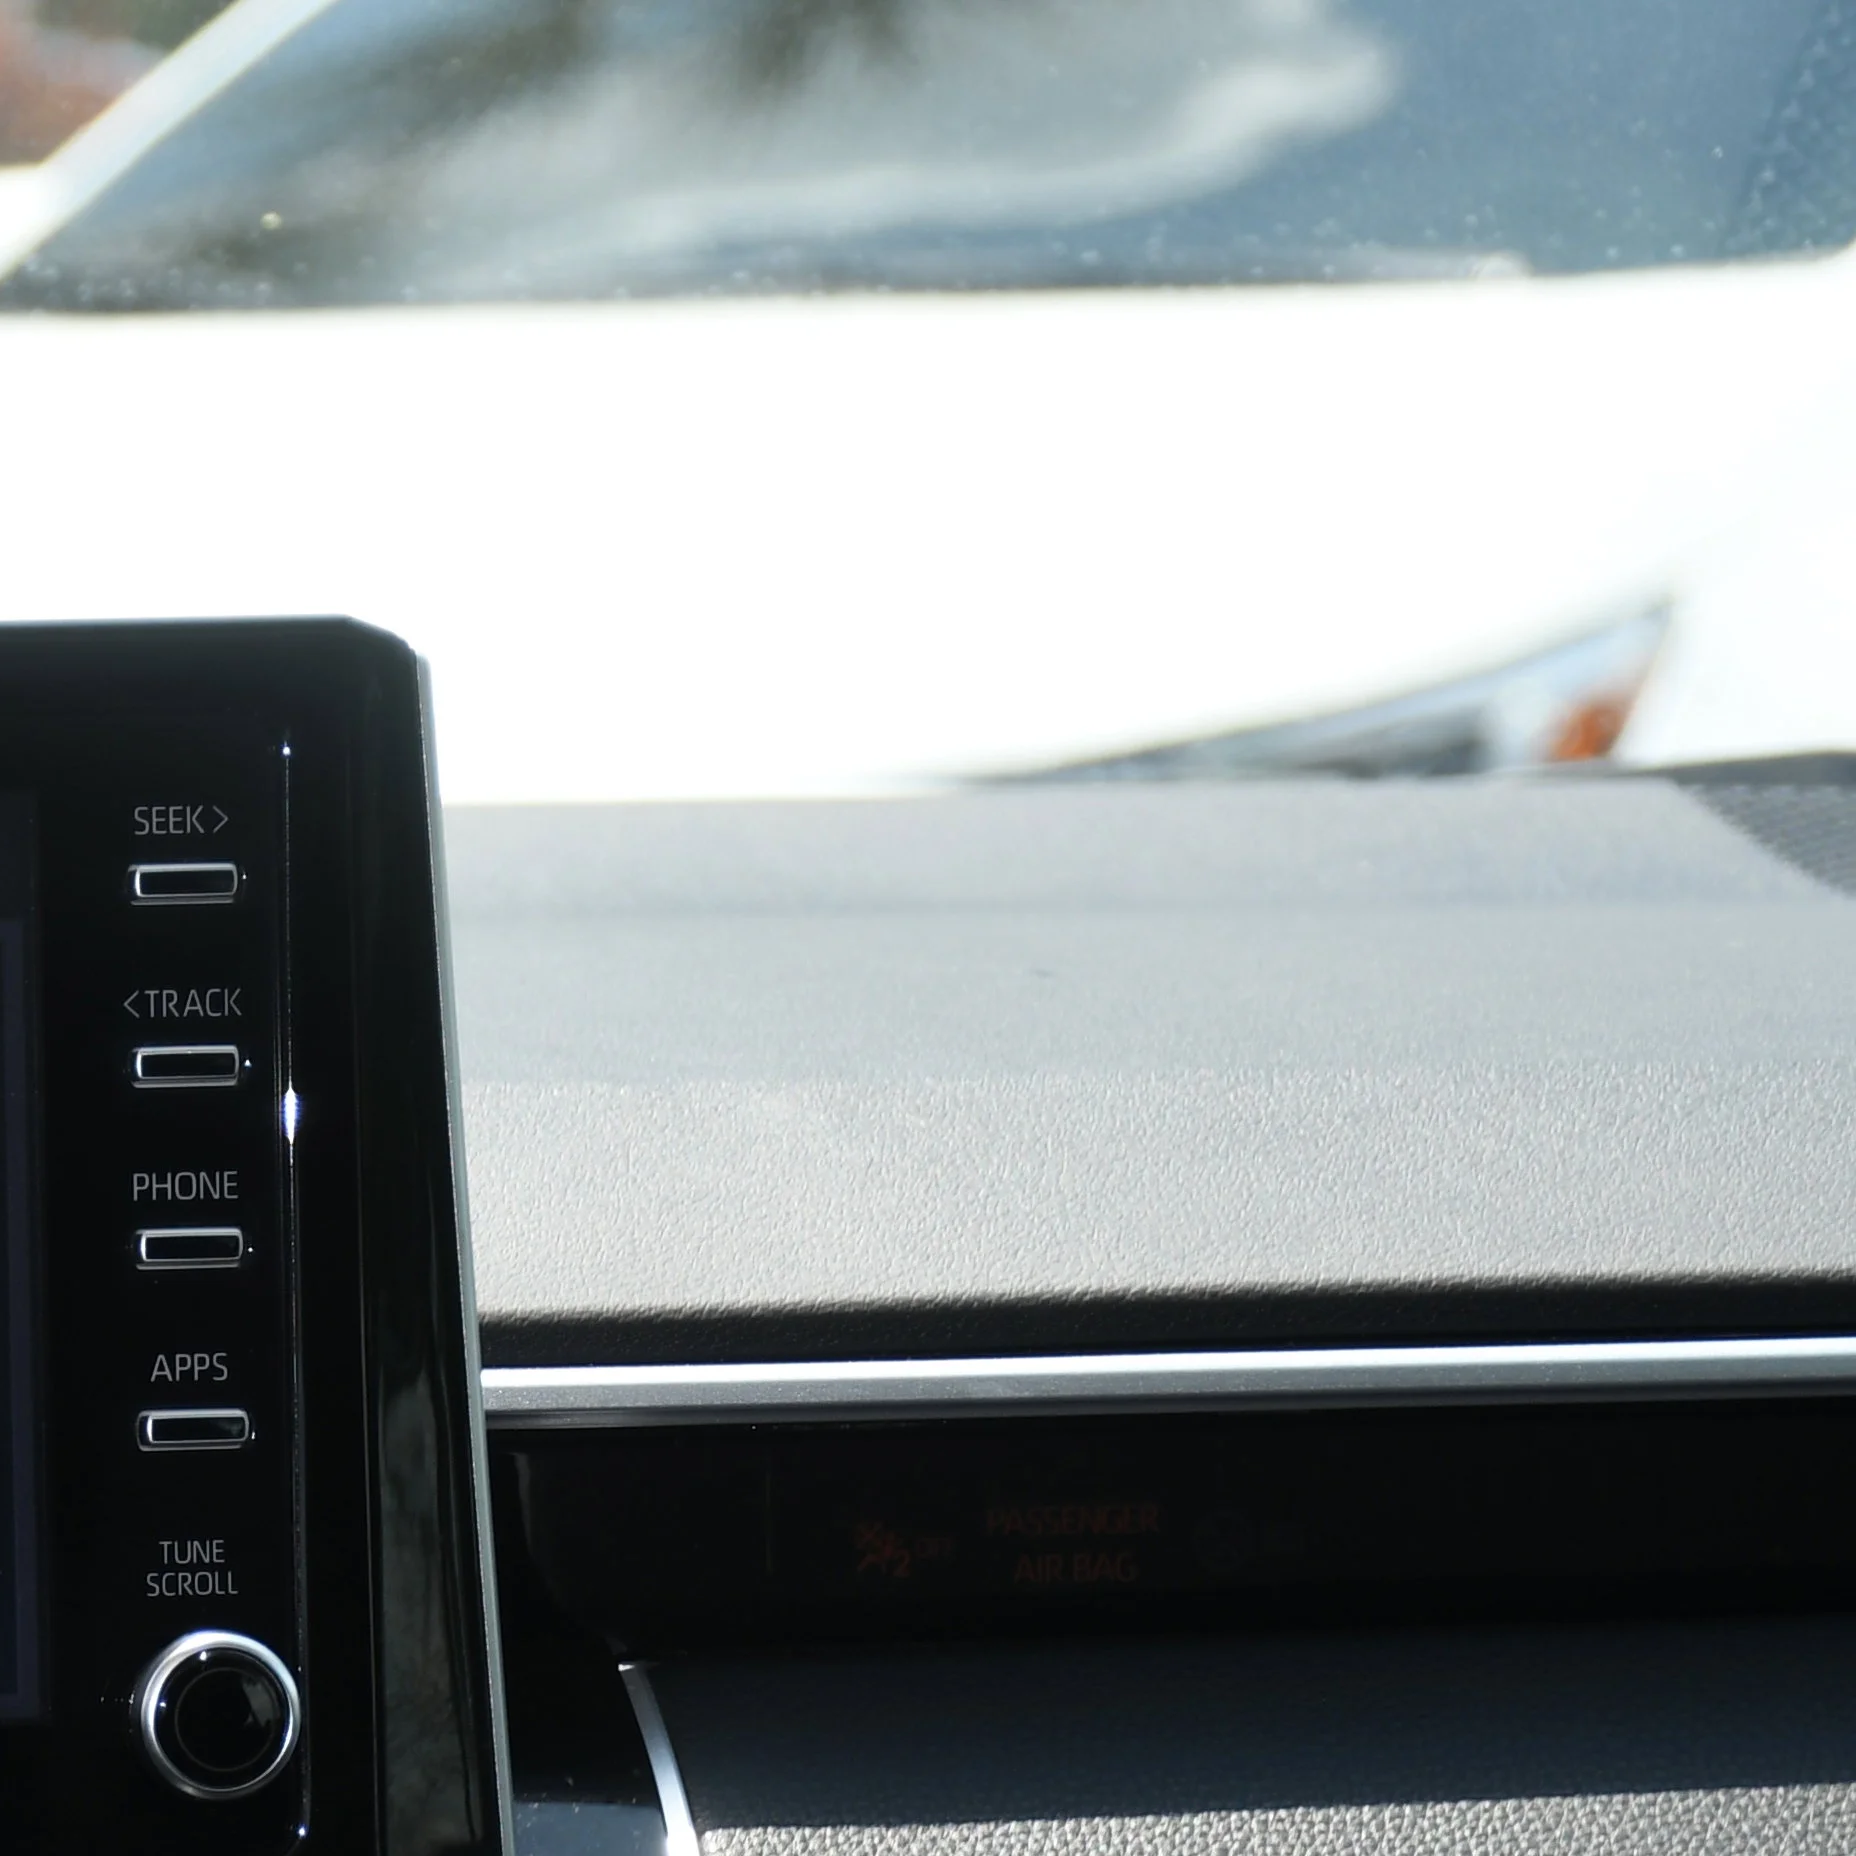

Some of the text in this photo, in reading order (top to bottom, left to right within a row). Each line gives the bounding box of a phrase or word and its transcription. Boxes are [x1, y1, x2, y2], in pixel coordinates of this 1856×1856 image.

[132, 1170, 240, 1202] PHONE
[150, 1352, 229, 1383] APPS
[987, 1502, 1162, 1537] PASSENGER
[159, 1540, 226, 1565] TUNE
[145, 1570, 239, 1597] SCROLL
